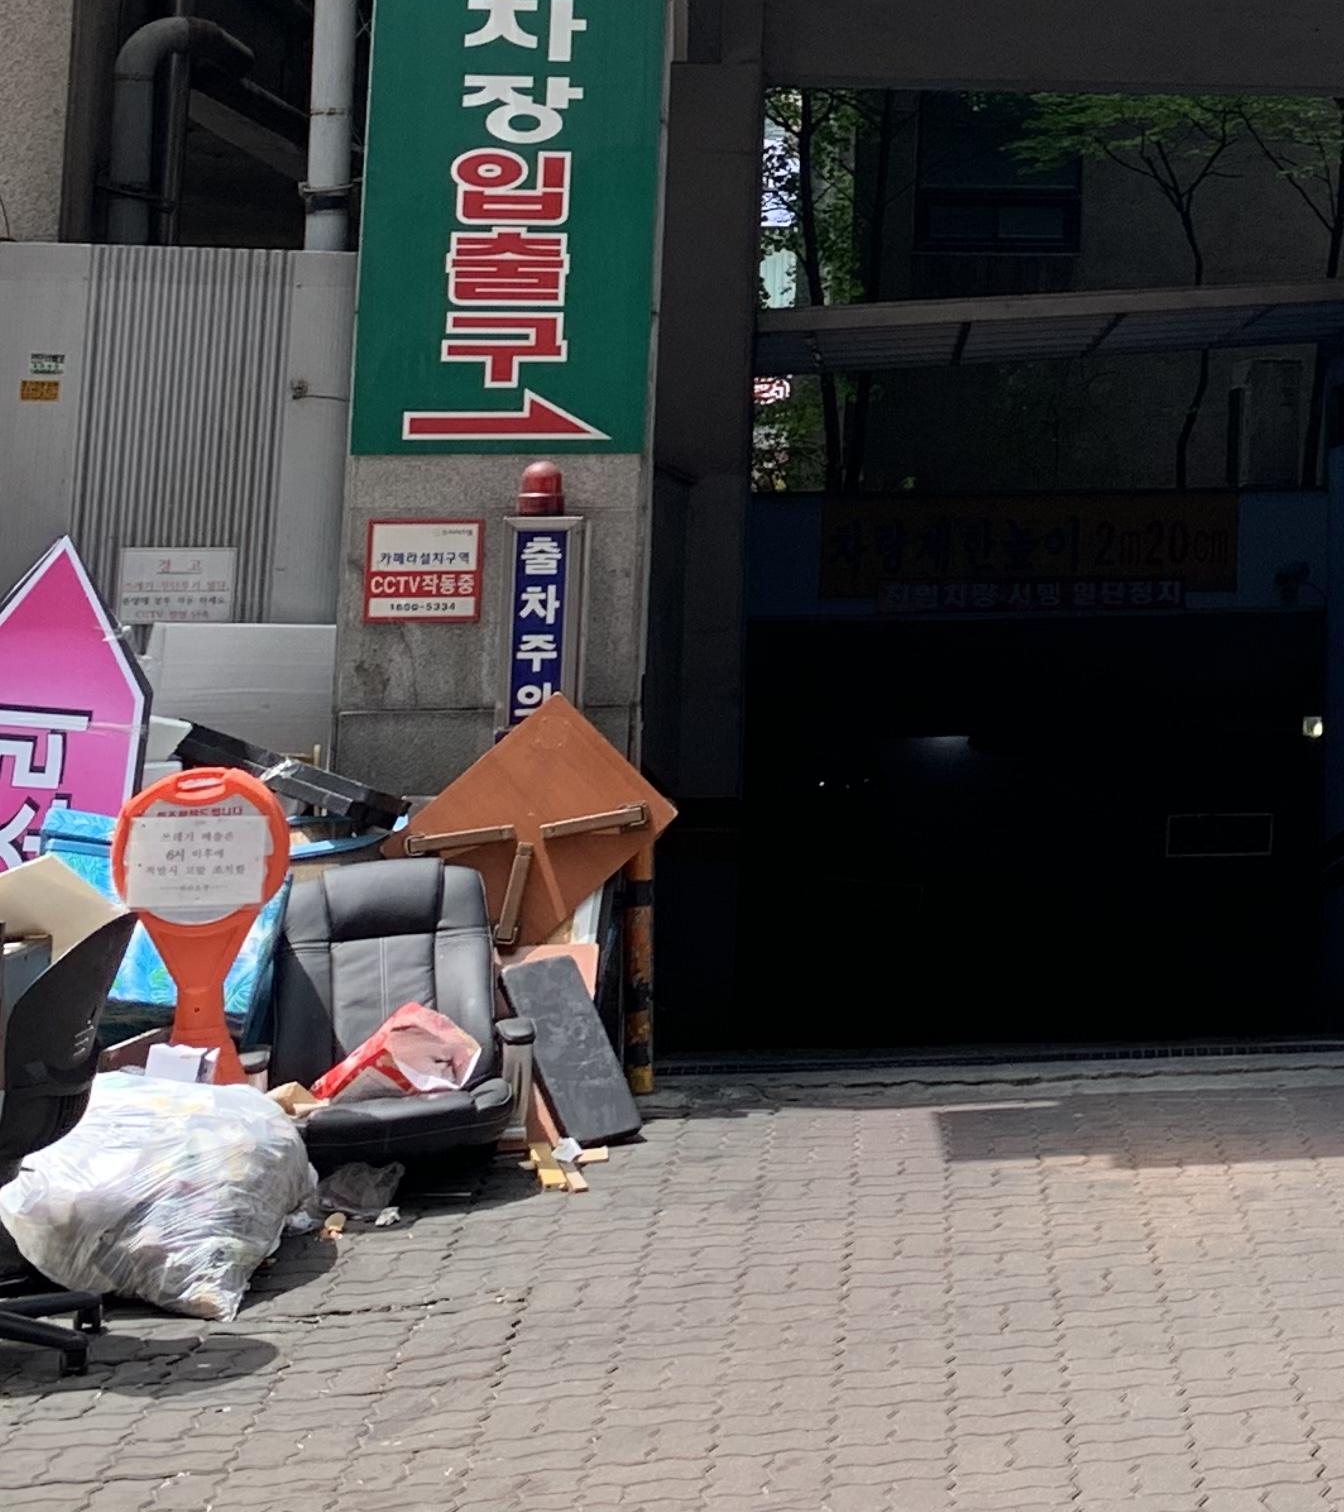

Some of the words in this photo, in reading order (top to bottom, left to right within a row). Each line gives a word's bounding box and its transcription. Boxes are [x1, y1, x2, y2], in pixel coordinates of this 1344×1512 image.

[440, 147, 573, 390] 입출구
[370, 573, 475, 596] CCTV작동중
[379, 551, 470, 566] 카메라설치구역
[513, 536, 563, 717] 출차주의
